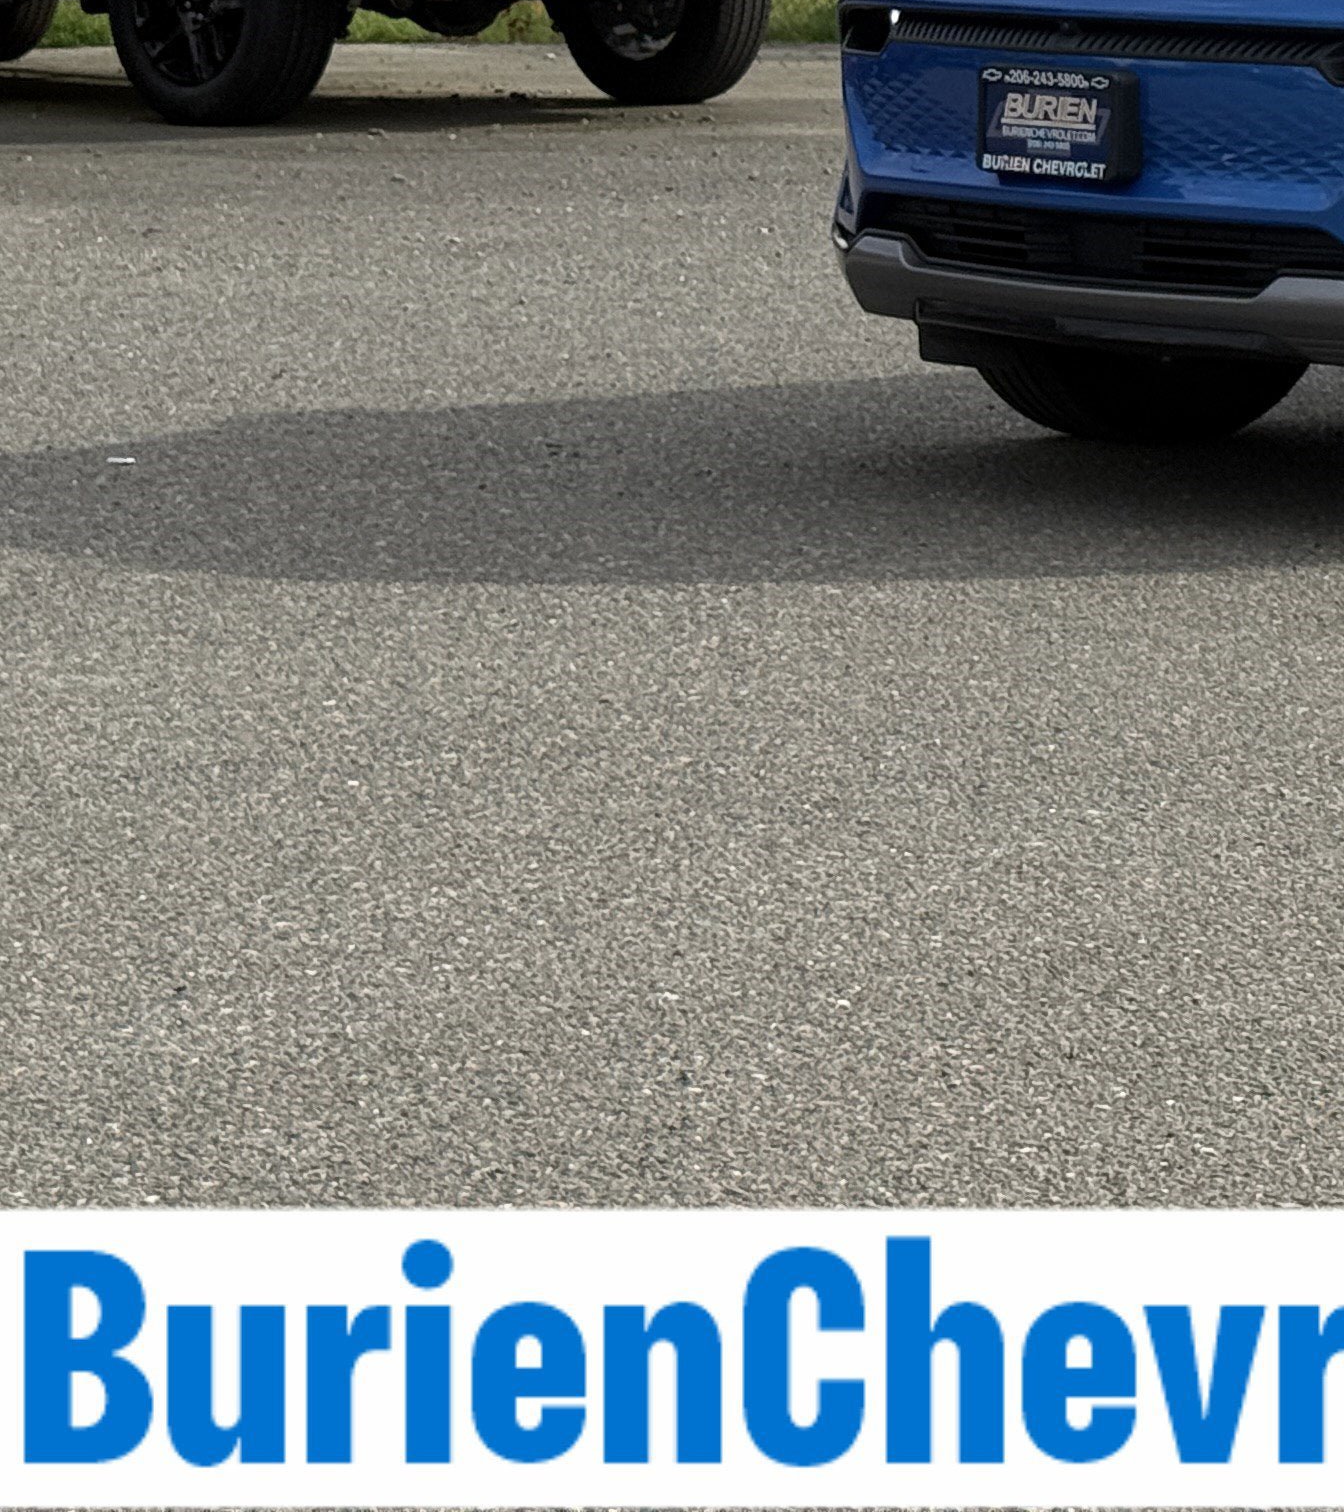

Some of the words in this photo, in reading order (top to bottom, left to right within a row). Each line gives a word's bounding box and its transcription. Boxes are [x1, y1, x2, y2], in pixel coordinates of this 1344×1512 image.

[1008, 69, 1085, 88] 206-243-5800
[1004, 92, 1098, 124] BURIEN
[982, 154, 1031, 173] BURIEN
[1033, 158, 1106, 181] CHEVROLET
